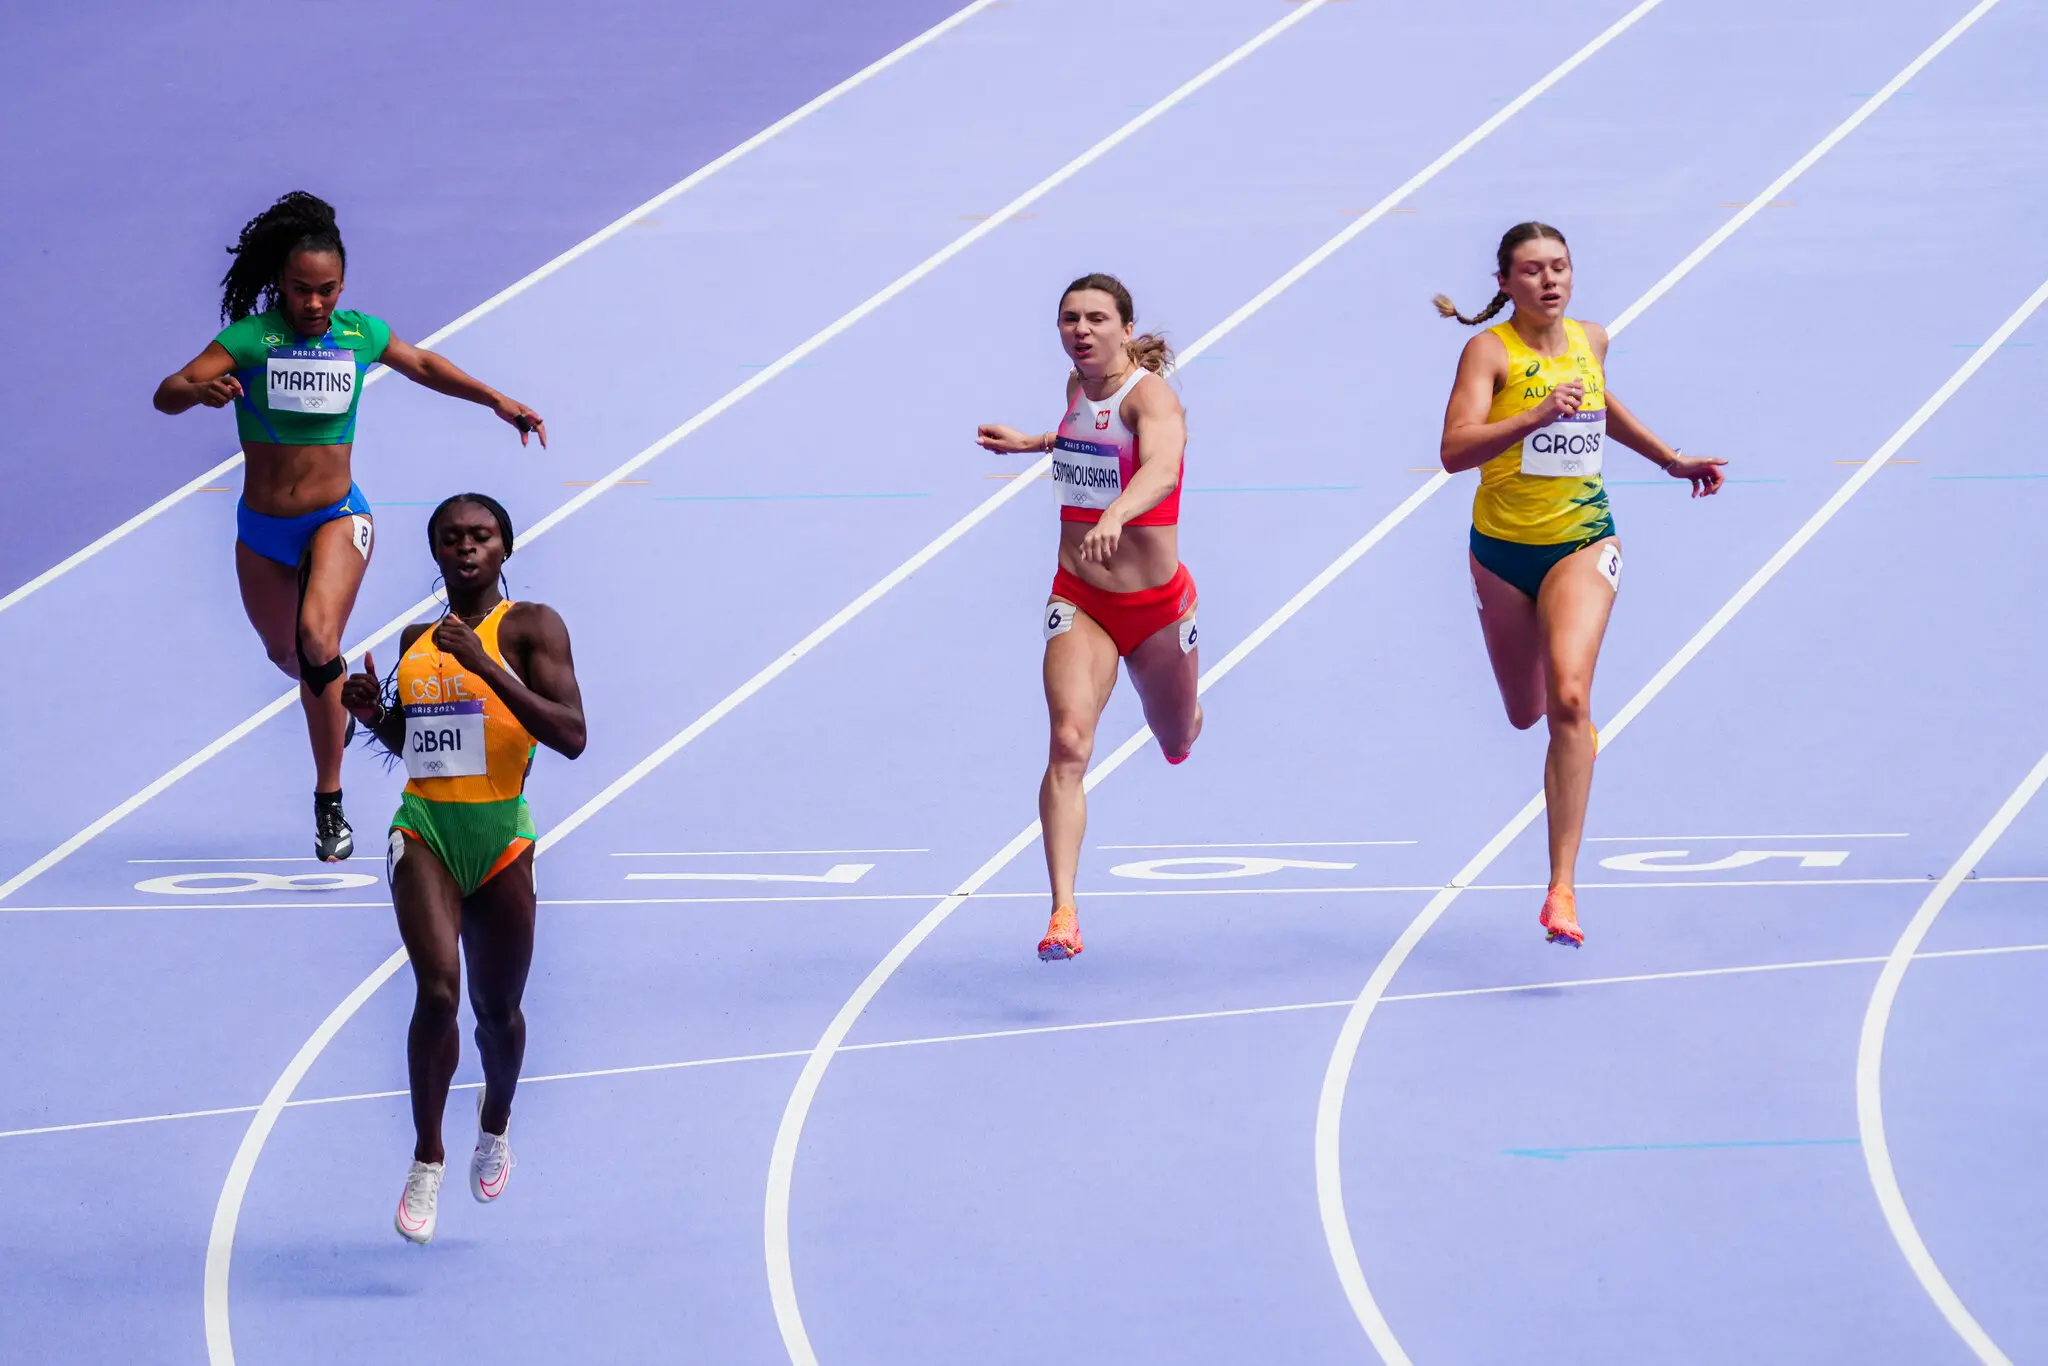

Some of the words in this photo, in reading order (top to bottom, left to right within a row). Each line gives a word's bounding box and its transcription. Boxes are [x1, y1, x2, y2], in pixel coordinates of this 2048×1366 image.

[271, 370, 351, 392] MARTINS
[1532, 433, 1600, 454] GROSS
[361, 525, 368, 547] 8
[1609, 554, 1618, 576] 5
[1048, 608, 1061, 629] 6
[1188, 624, 1197, 645] 6
[411, 674, 468, 701] CÔTE
[412, 729, 461, 753] GBAI
[1109, 857, 1357, 880] 6
[1598, 850, 1850, 872] 5
[133, 872, 379, 895] 8
